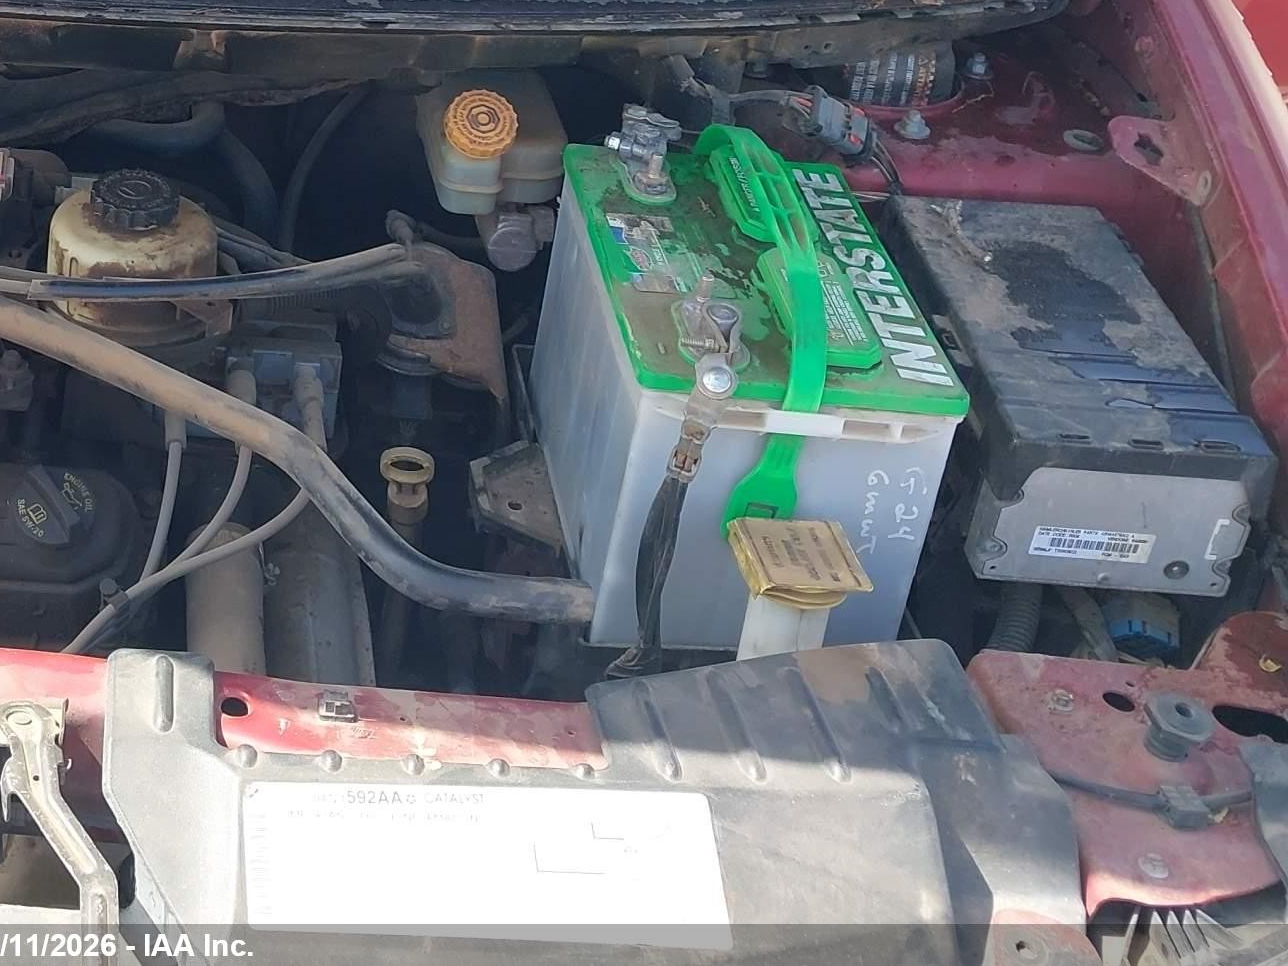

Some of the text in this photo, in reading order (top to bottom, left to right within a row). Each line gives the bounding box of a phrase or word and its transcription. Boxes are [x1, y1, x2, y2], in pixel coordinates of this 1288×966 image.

[792, 168, 955, 387] INTERSTATE
[63, 472, 93, 513] ENGINE OIL
[17, 498, 44, 538] SAE 5W-20
[424, 792, 486, 805] CATALYST
